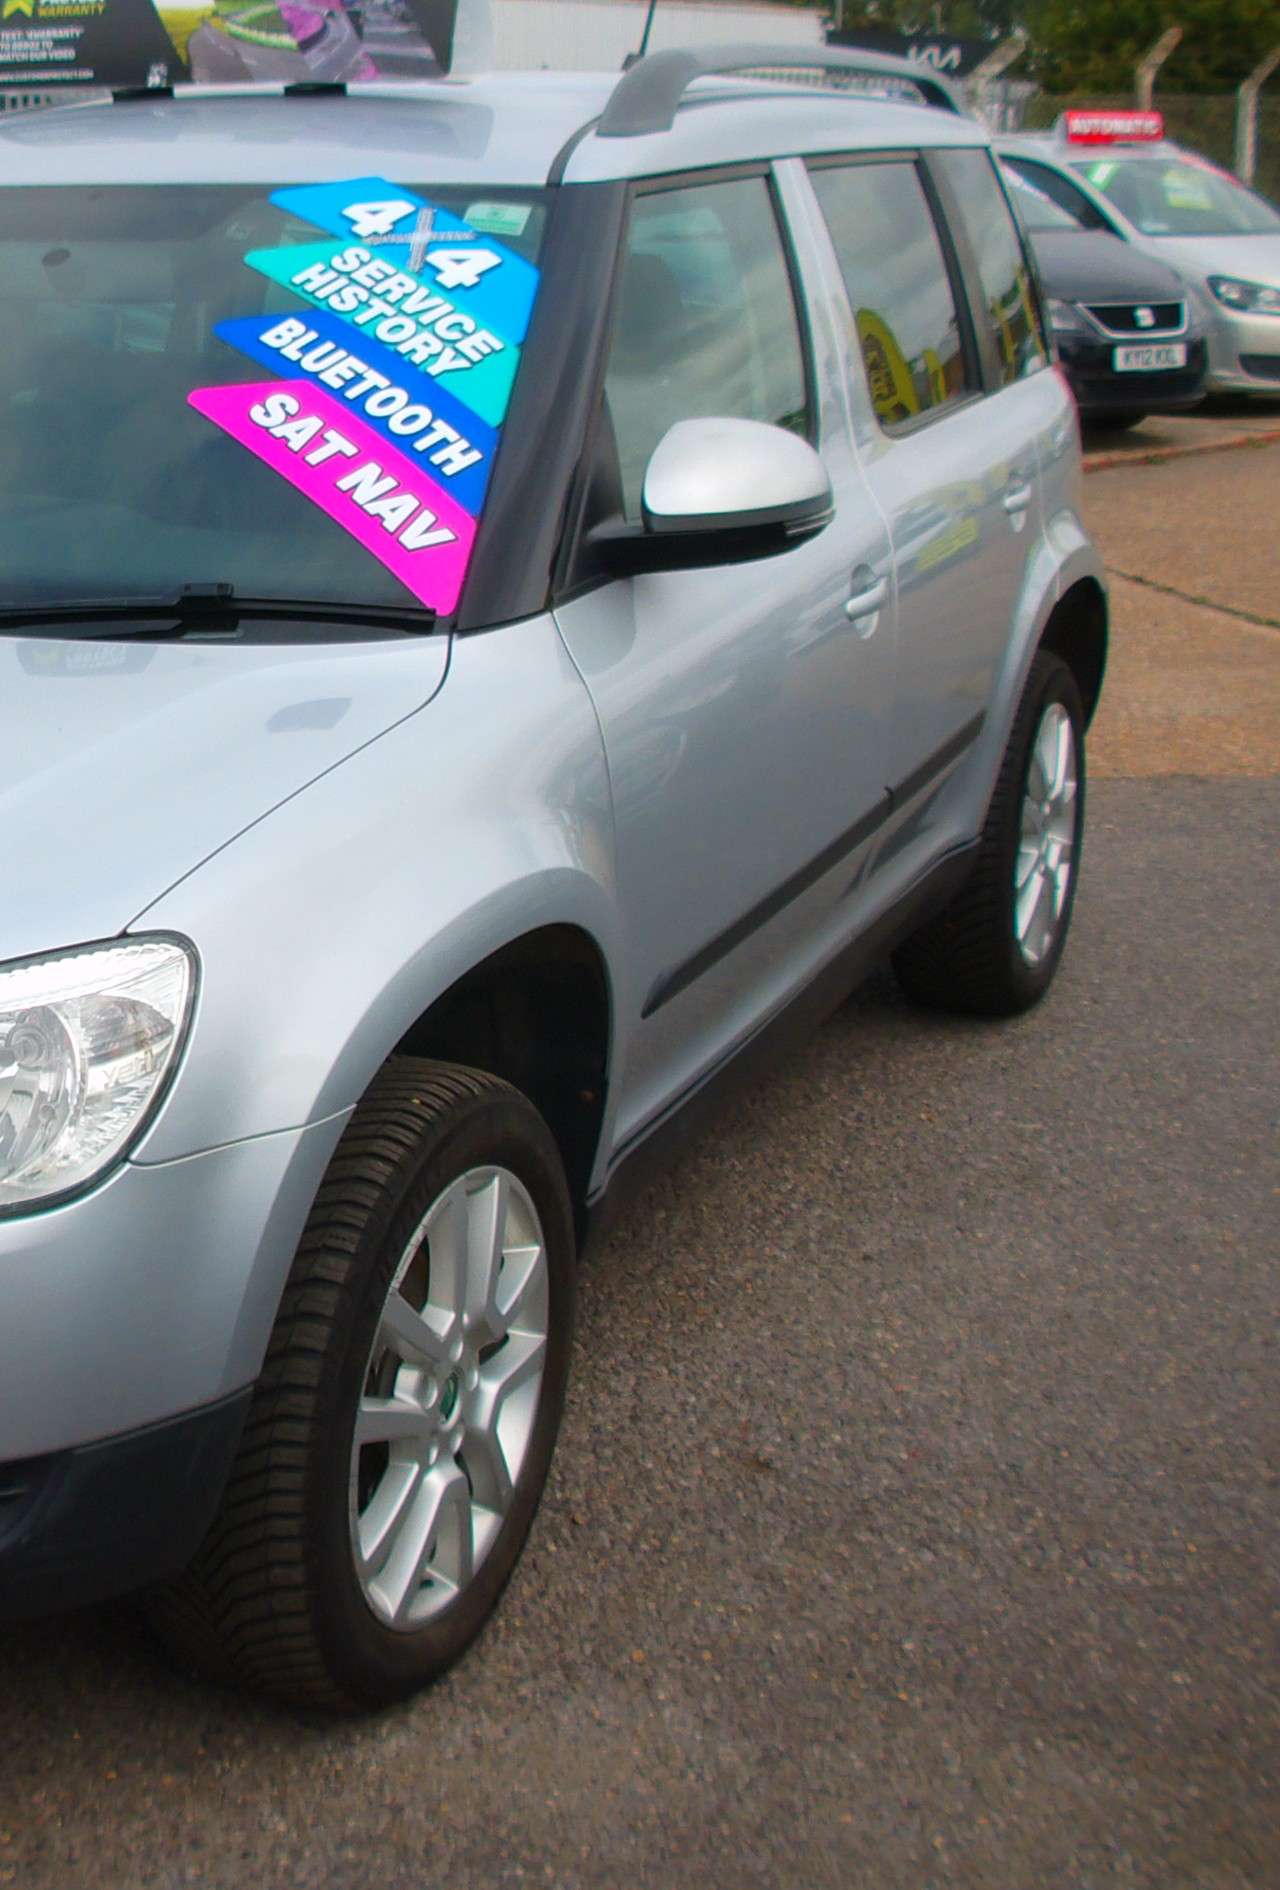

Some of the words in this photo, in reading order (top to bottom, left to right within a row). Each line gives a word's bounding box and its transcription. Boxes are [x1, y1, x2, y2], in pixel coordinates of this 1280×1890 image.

[1070, 118, 1161, 135] AUTOMATIC
[290, 261, 474, 377] HISTORY
[330, 246, 506, 363] SERVICE
[258, 317, 484, 477] BLUETOOTH
[248, 393, 361, 468] SAT
[335, 461, 459, 553] NAV
